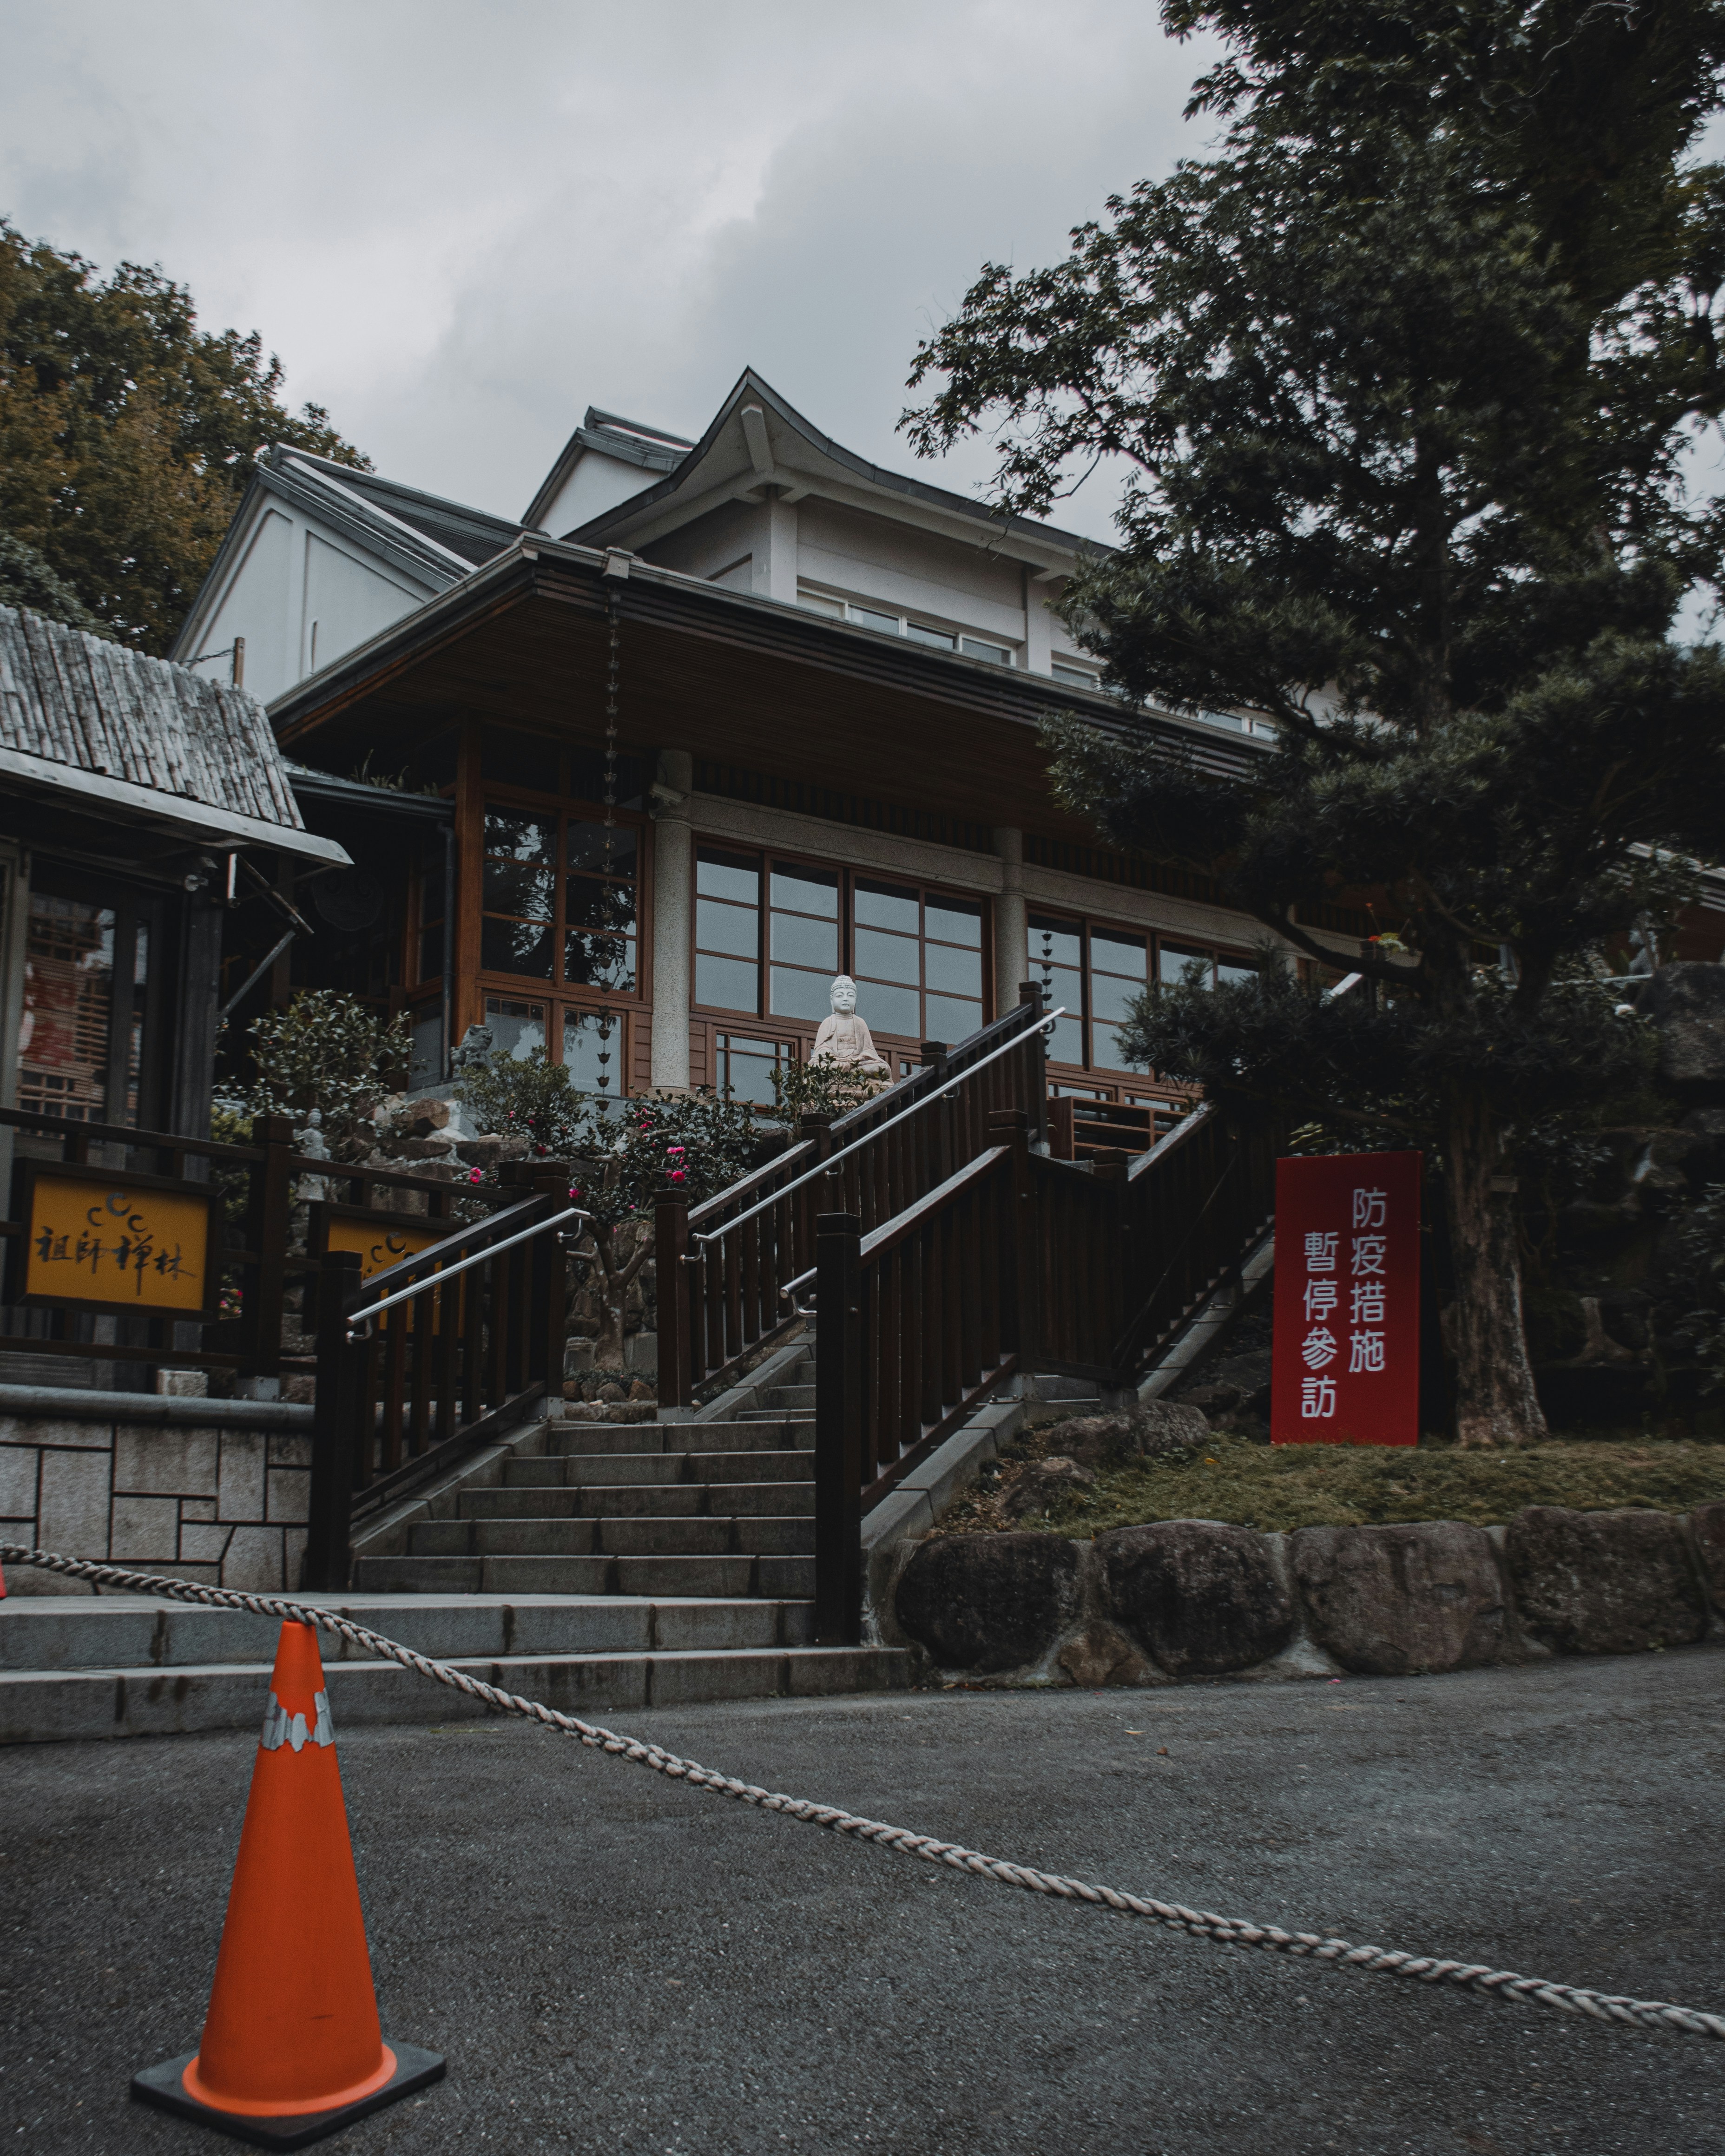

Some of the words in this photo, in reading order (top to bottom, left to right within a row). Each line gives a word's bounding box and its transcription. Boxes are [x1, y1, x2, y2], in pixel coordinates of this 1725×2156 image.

[1302, 1232, 1339, 1418] 暫停參訪
[1349, 1187, 1387, 1373] 防疫措施
